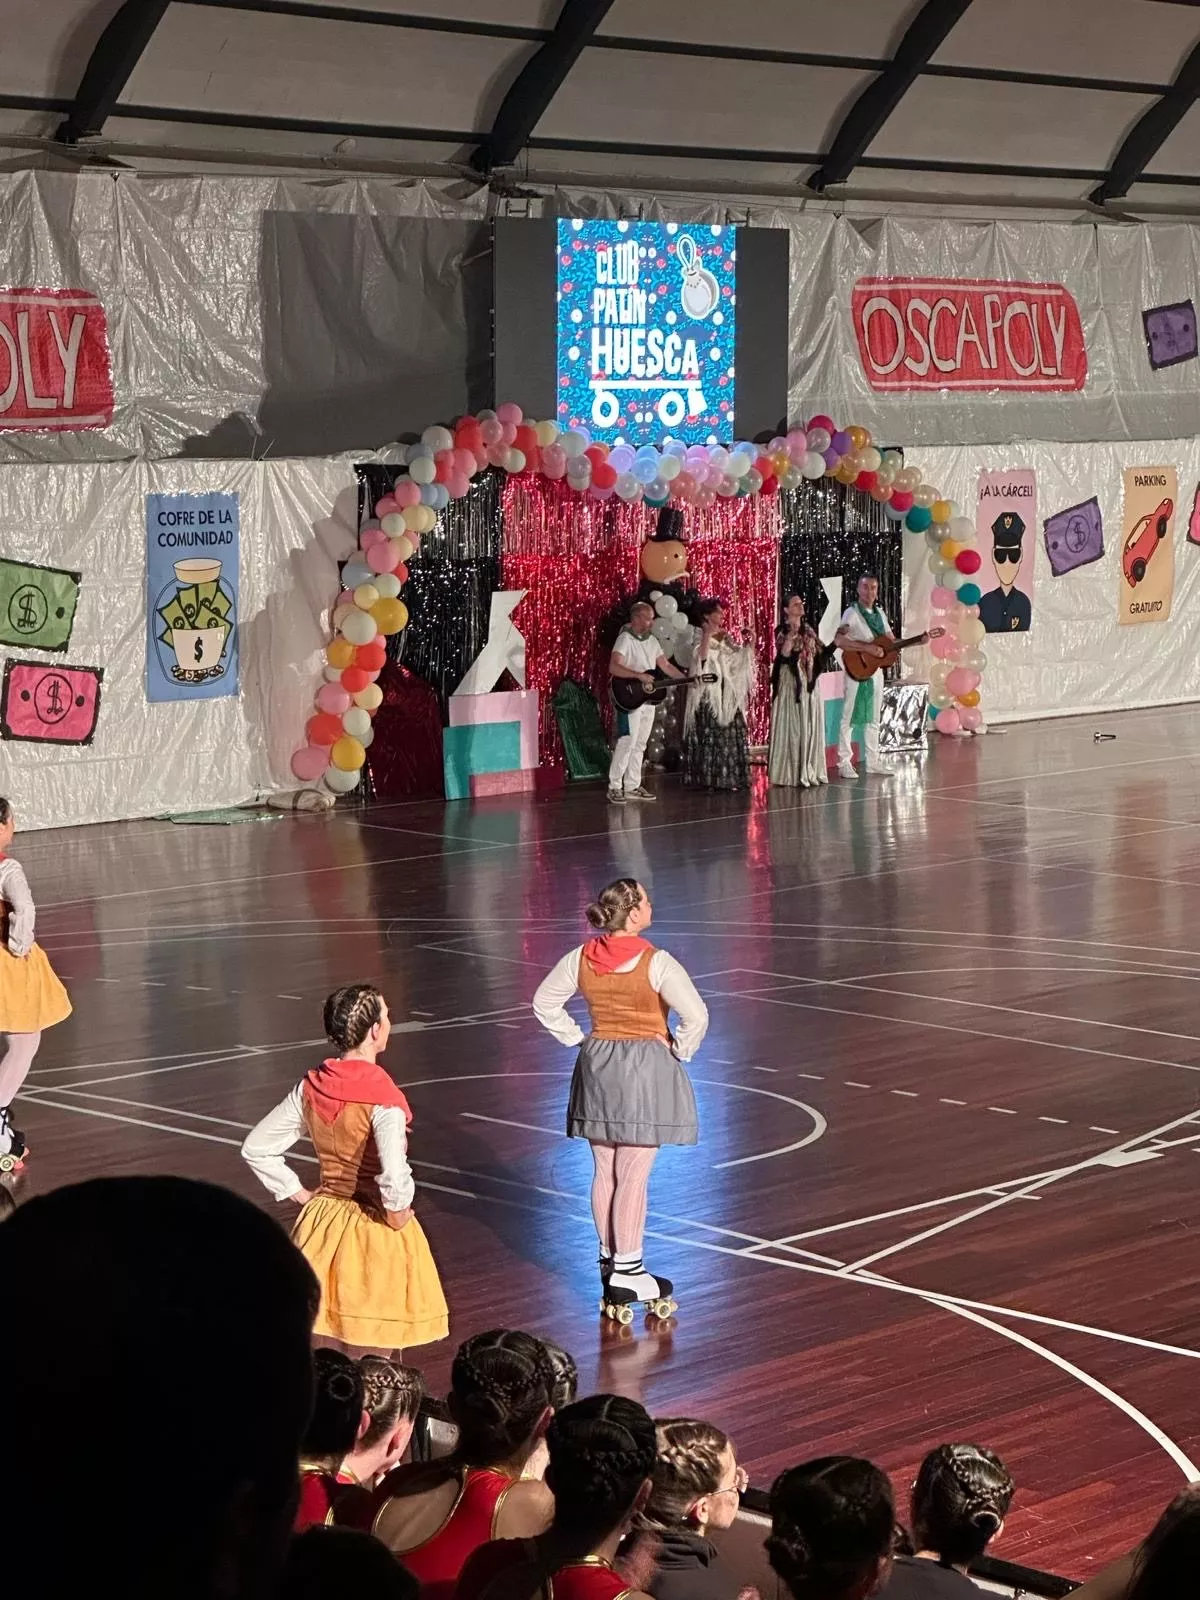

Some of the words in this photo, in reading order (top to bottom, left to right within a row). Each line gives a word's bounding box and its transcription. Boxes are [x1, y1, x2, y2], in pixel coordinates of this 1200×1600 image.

[596, 239, 640, 285] CLUB
[862, 294, 1066, 377] OSCAPOLY
[591, 327, 700, 377] HUESCA
[1134, 475, 1167, 486] PARKING
[157, 511, 195, 526] COFRE
[198, 510, 215, 524] DE
[218, 509, 233, 524] LA
[157, 530, 233, 547] COMUNIDAD
[1130, 600, 1163, 614] GRATUITO
[194, 636, 204, 663] $
